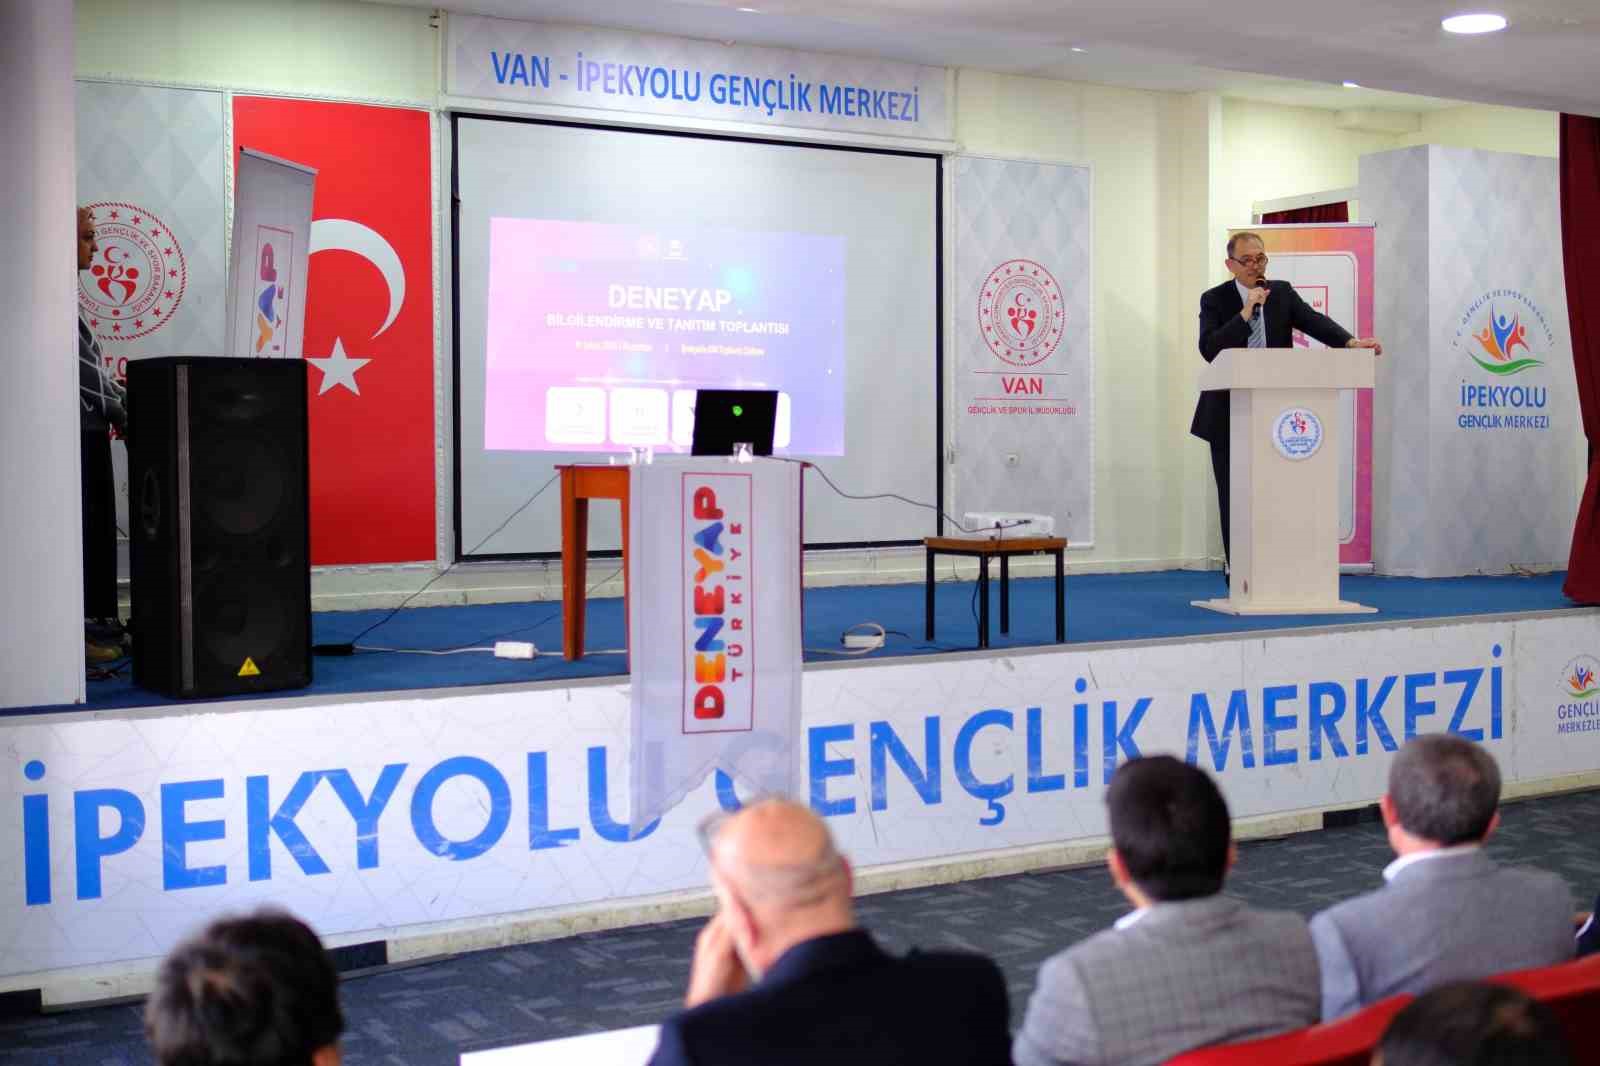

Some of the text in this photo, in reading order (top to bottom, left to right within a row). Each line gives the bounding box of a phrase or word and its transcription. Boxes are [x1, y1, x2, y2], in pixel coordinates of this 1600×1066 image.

[490, 51, 550, 88] VAN
[576, 51, 701, 102] İPEKYOLU
[709, 72, 811, 116] GENÇLİK
[819, 84, 919, 122] MERKEZİ
[607, 284, 731, 313] DENEYAP
[647, 317, 664, 330] VE
[668, 318, 715, 332] TANITIM
[720, 320, 789, 336] TOPLANTISI
[1001, 377, 1043, 395] VAN
[1460, 379, 1547, 408] İPEKYOLU
[1458, 413, 1550, 431] GENÇLİK MERKEZİ
[693, 486, 726, 719] DENEYAP
[726, 523, 743, 683] TÜRKİYE
[1558, 699, 1600, 720] GENÇLİ
[1558, 720, 1600, 734] MERKEZLE
[22, 643, 1503, 906] İPEKYOLU ENÇLİK MERKEZİ
